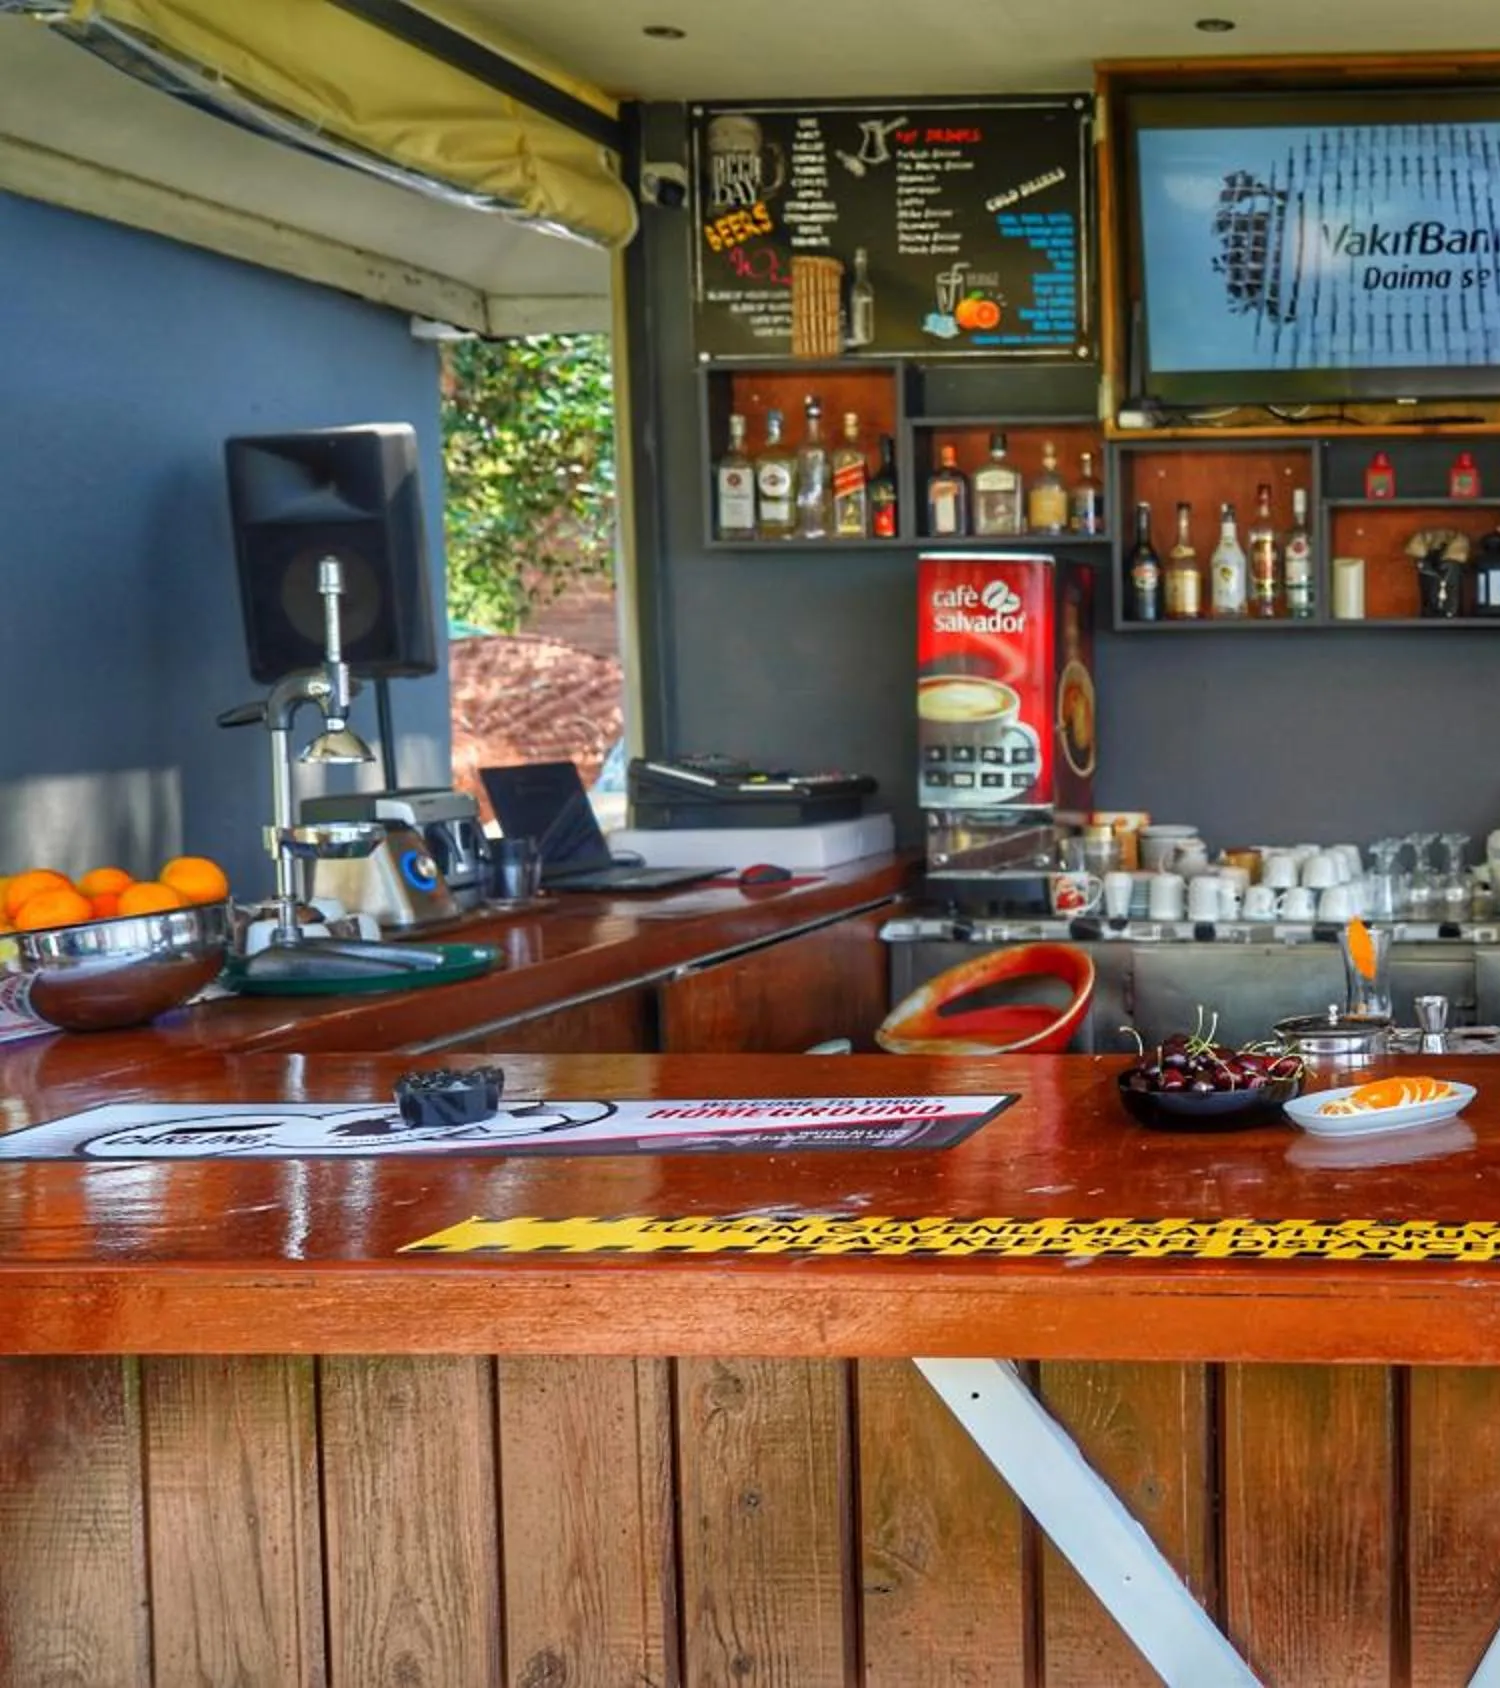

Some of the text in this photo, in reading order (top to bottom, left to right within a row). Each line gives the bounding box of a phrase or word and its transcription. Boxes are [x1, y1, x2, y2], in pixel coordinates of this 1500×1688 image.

[704, 200, 773, 252] BEERS
[1362, 264, 1452, 290] Daima
[933, 609, 1027, 633] salvador
[755, 1235, 936, 1245] PLEASE
[949, 1236, 1071, 1247] KEEP
[1085, 1237, 1209, 1248] SAFE
